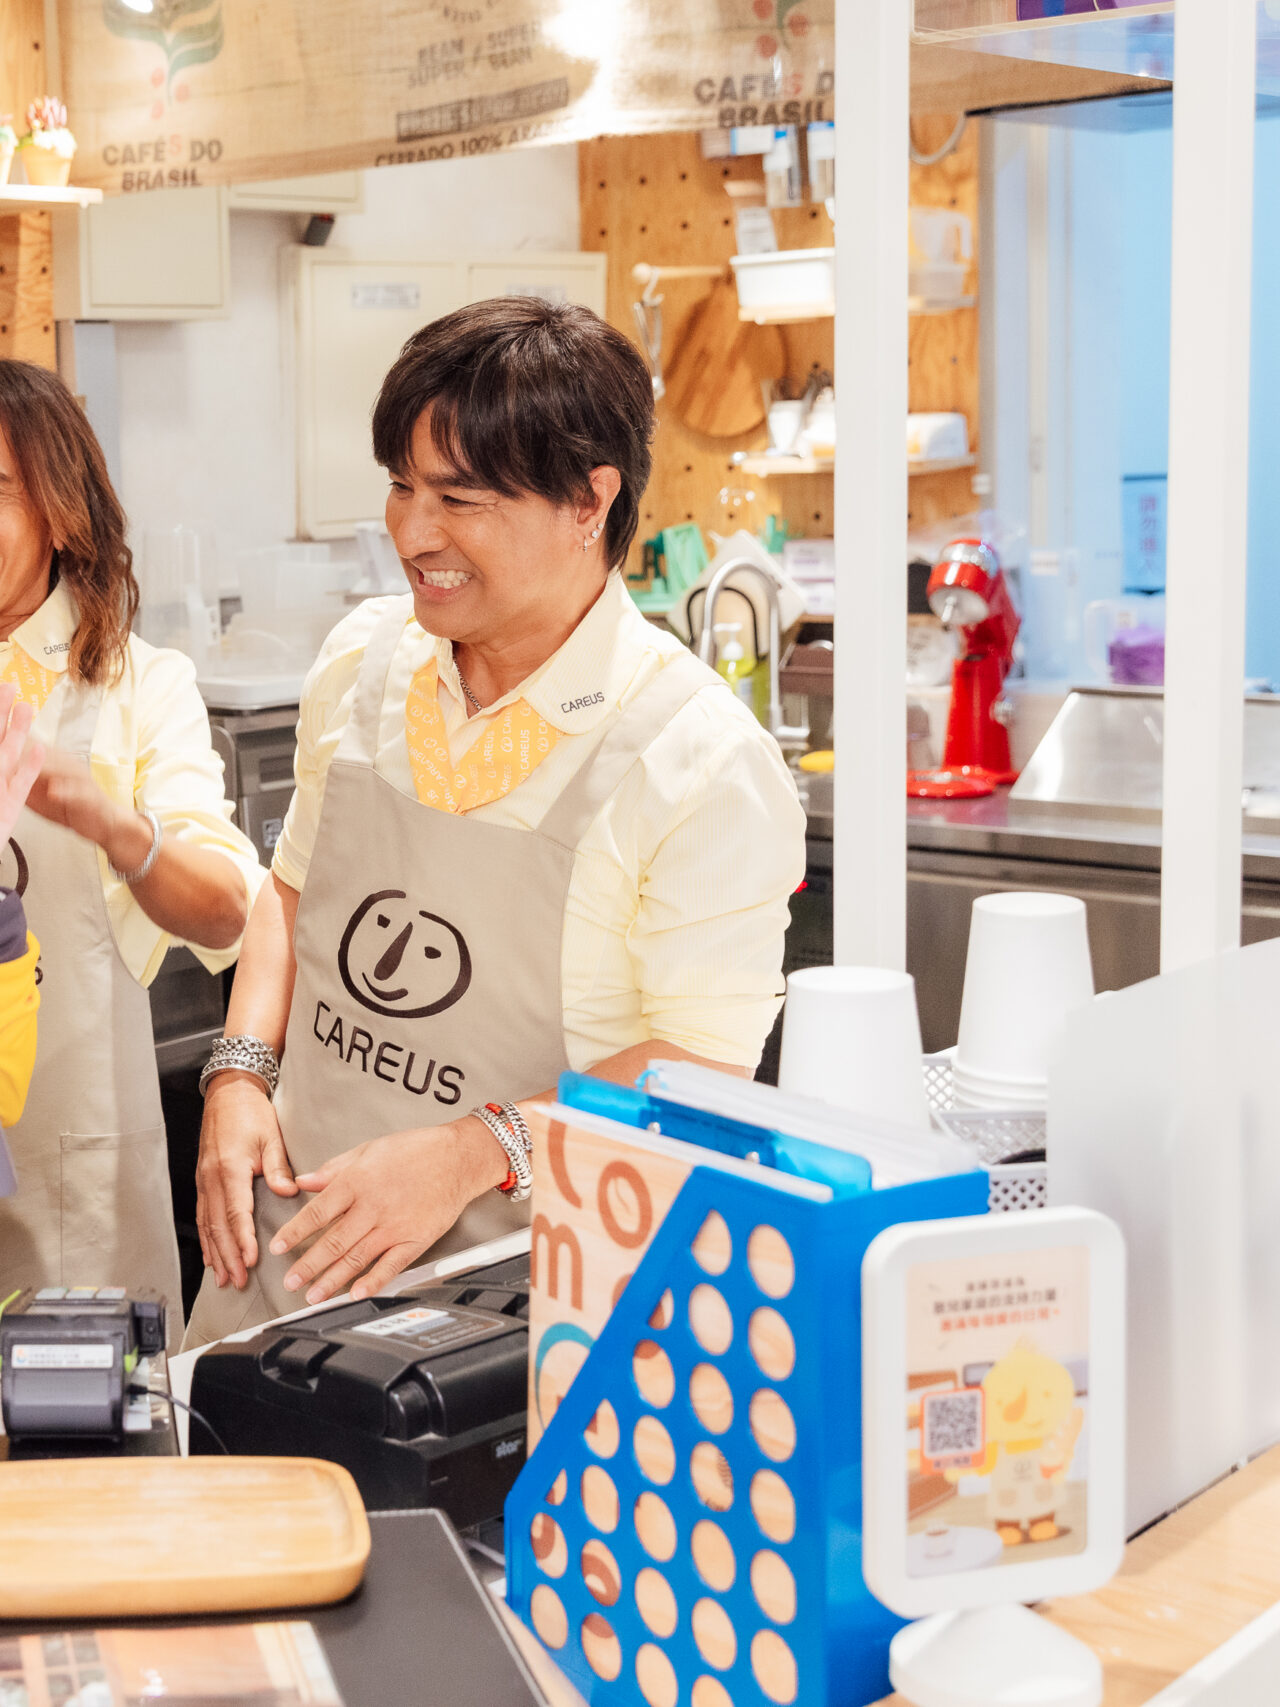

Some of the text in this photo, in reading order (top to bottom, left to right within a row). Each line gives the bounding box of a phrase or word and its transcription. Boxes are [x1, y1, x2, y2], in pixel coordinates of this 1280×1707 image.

[190, 138, 223, 163] DO
[122, 168, 202, 192] BRASIL
[561, 692, 605, 714] CAREUS
[520, 729, 530, 770] CAREUS
[313, 1000, 465, 1105] CAREUS
